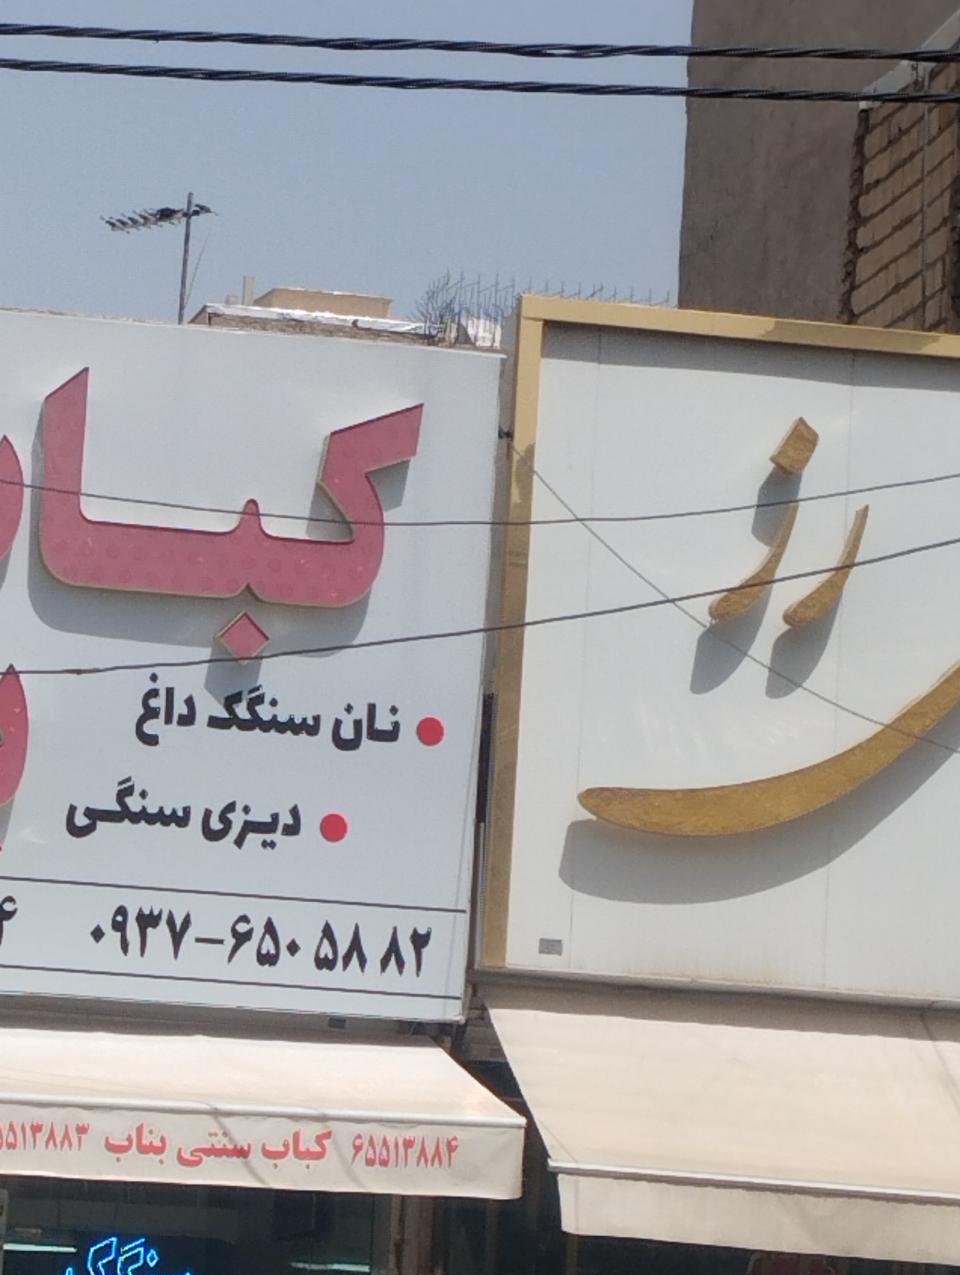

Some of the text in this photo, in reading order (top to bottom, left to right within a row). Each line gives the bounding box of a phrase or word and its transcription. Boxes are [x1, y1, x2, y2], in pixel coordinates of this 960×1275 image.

[135, 671, 401, 752] نان سنگک داغ
[65, 776, 302, 850] دیزی سنگی
[103, 1122, 168, 1164] بناب
[176, 1130, 252, 1168] سنتی
[261, 1127, 333, 1170] کباب
[350, 1132, 460, 1168] ۶۵۵۱۳۸۸۴
